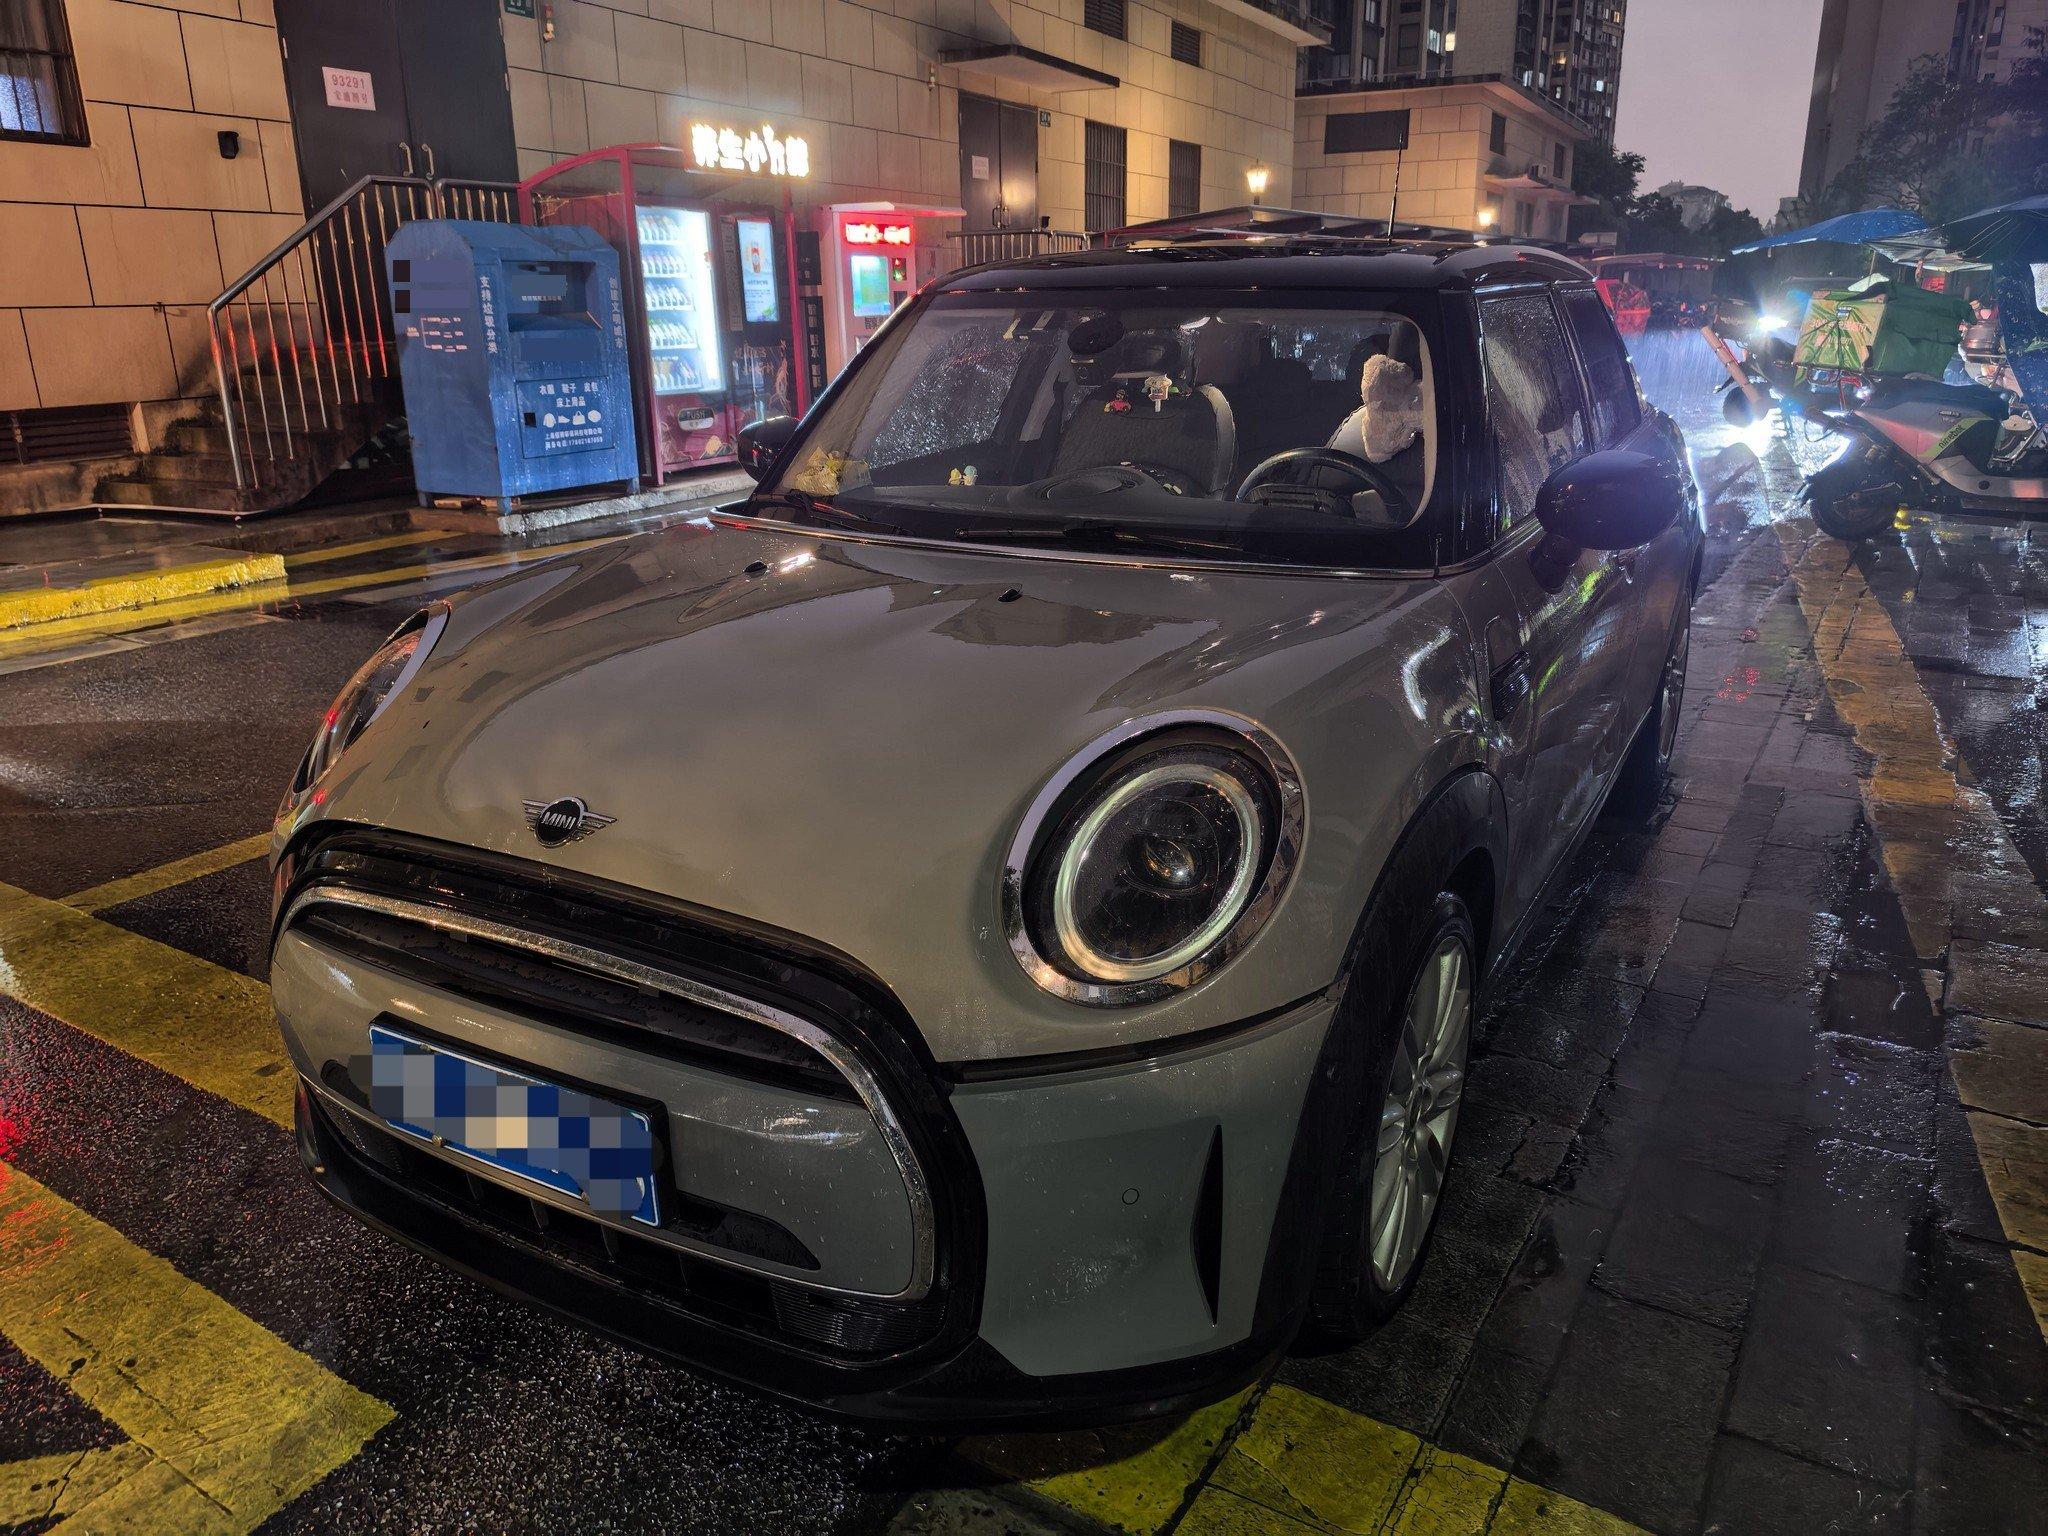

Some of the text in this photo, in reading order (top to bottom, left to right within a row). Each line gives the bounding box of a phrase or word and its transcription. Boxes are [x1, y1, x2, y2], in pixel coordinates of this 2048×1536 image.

[480, 275, 498, 353] 支持垃圾分类
[556, 396, 586, 408] 床上用品
[1938, 424, 1964, 449] ninebot
[541, 811, 577, 830] MINI
